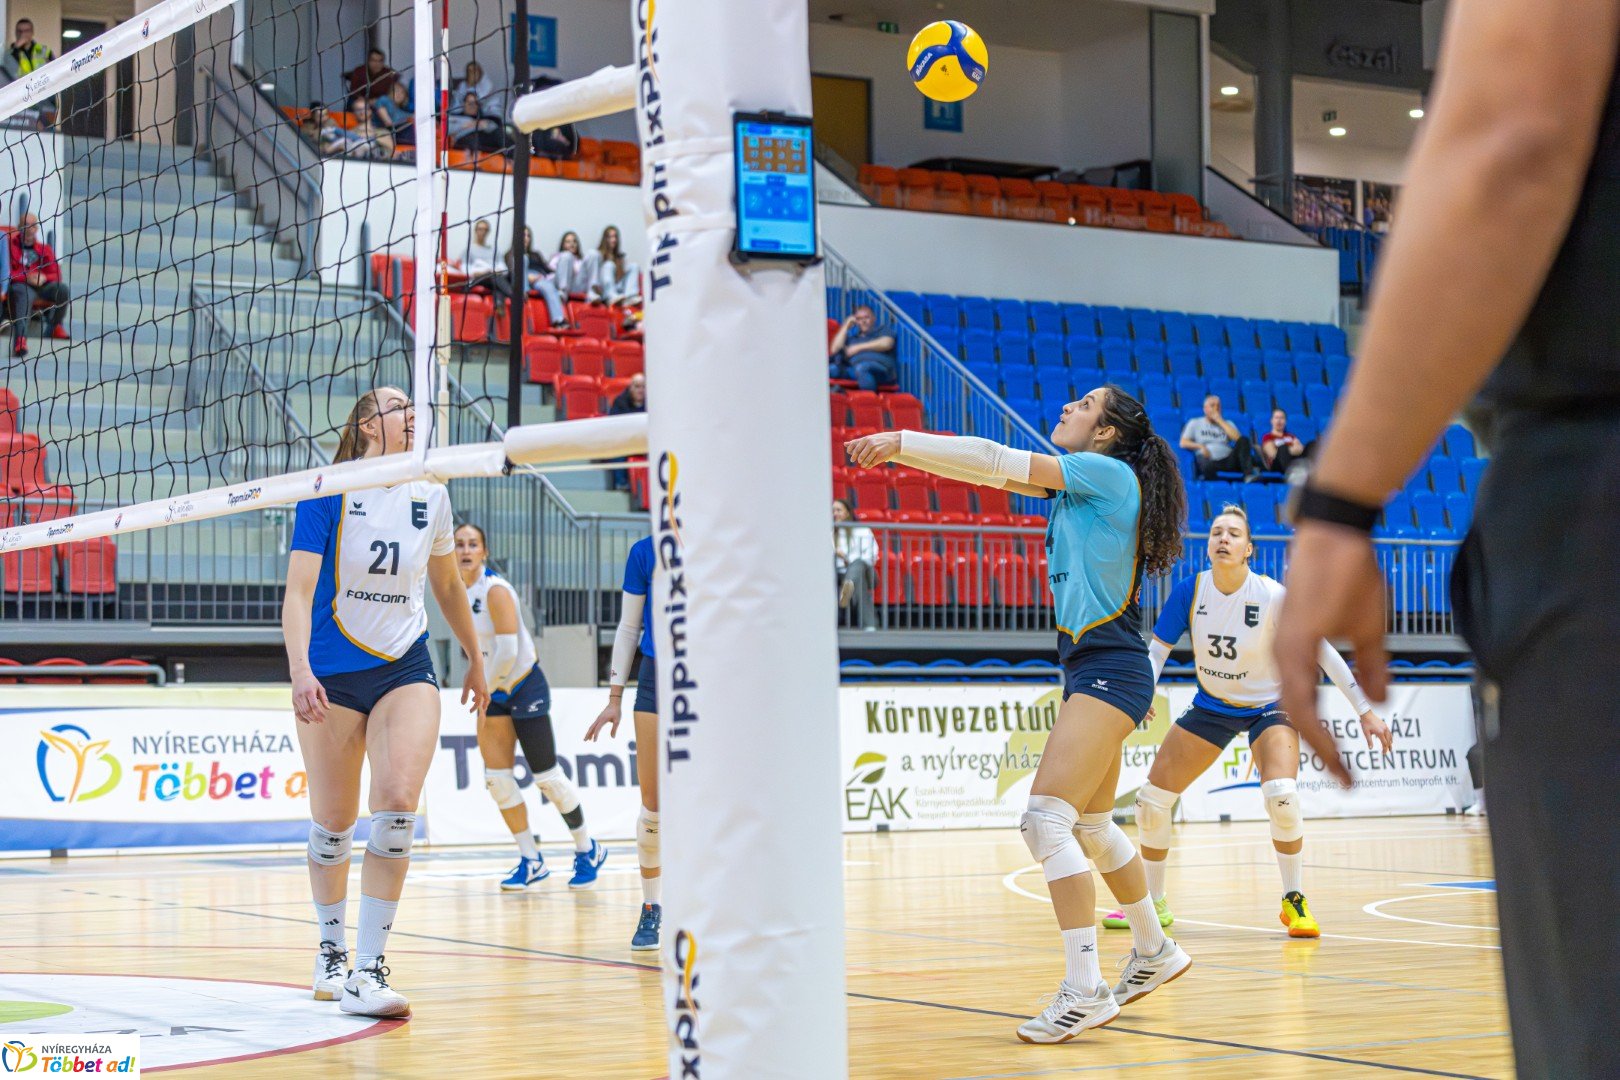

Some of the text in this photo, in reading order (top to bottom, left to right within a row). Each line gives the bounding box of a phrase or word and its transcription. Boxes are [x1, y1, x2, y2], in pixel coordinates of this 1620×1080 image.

[368, 540, 400, 575] 21
[658, 450, 698, 773] TippmixPRO
[1207, 633, 1238, 661] 33
[865, 700, 1059, 738] Környezettud
[132, 730, 294, 755] NYÍREGYHÁZA
[902, 755, 914, 771] a
[133, 761, 308, 802] Többet a
